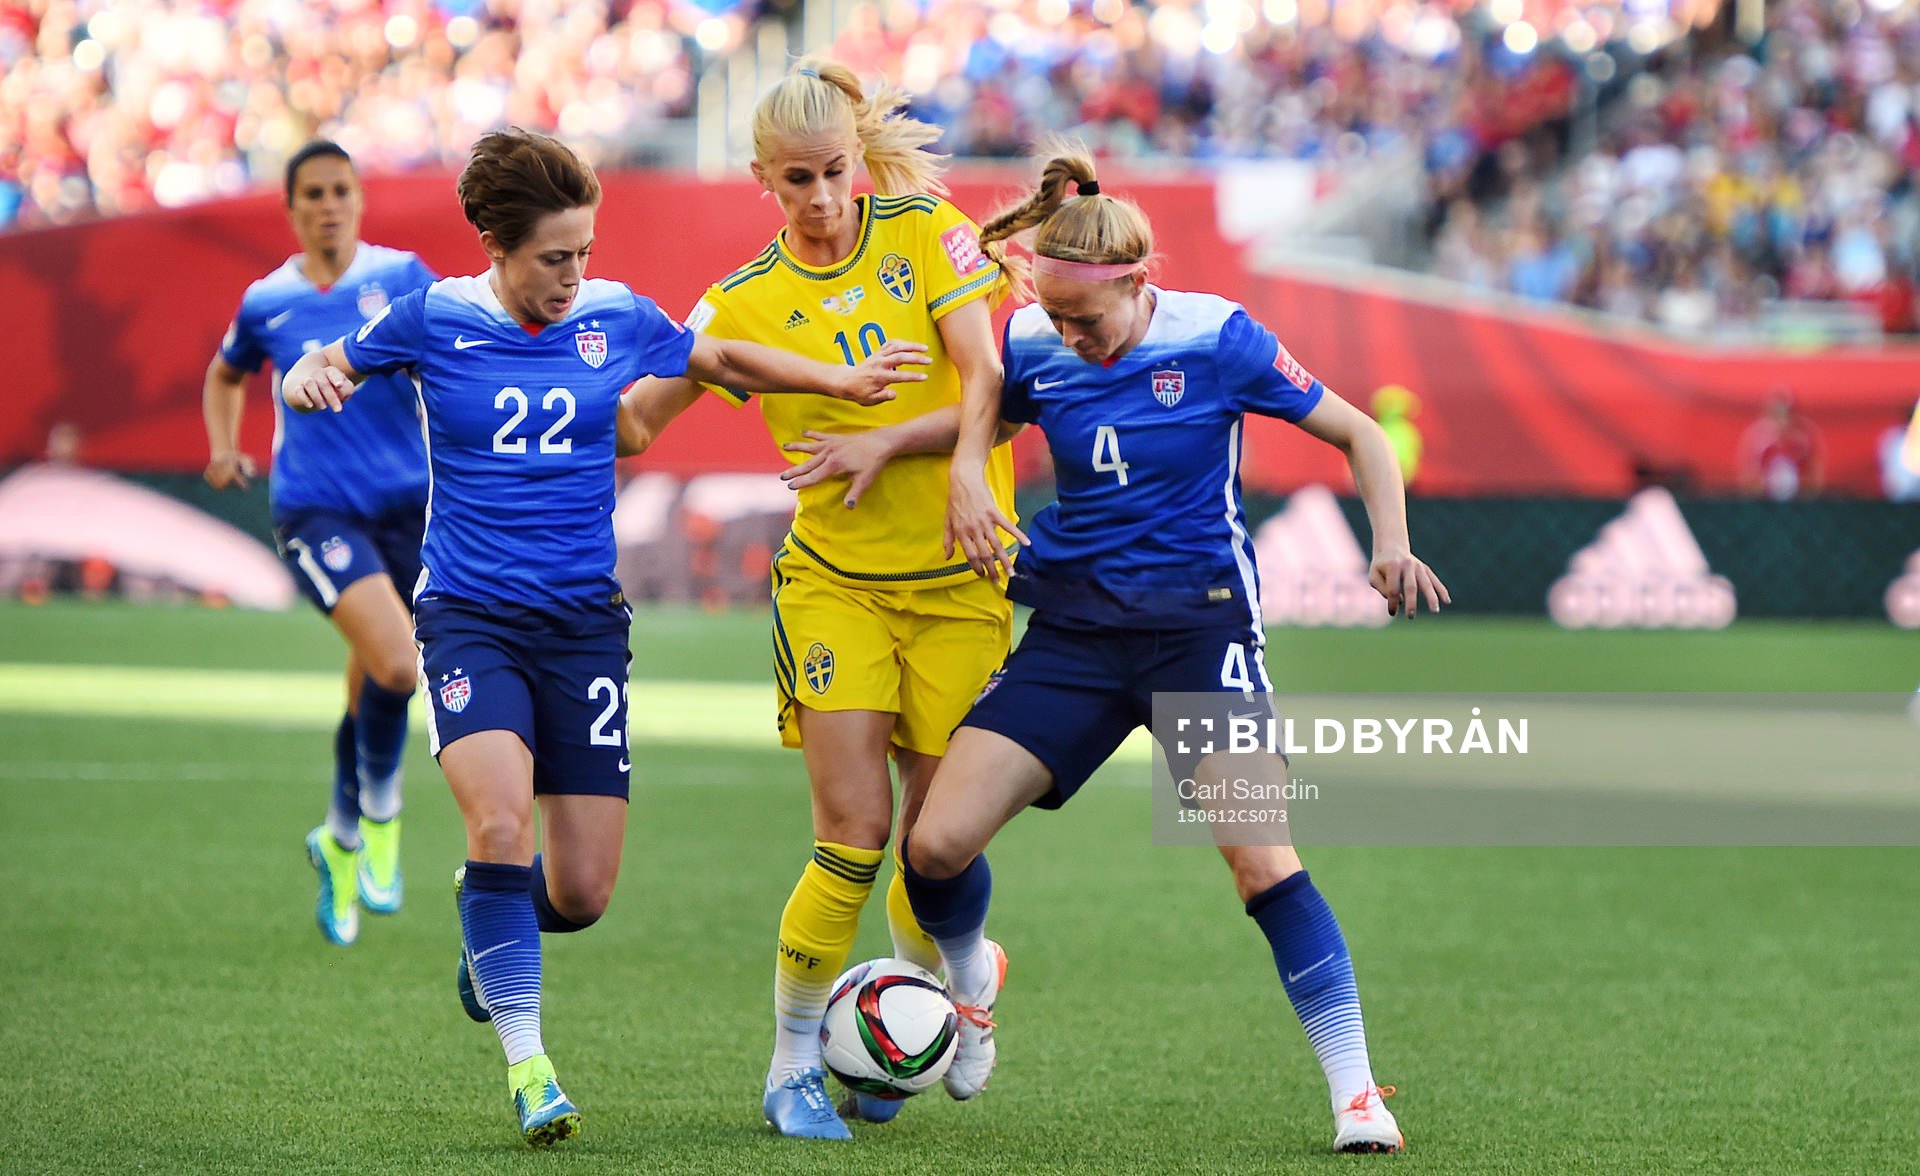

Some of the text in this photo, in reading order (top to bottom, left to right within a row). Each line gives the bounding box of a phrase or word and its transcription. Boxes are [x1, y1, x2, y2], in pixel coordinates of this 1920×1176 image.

[834, 322, 887, 367] 10
[492, 386, 576, 454] 22
[1092, 425, 1129, 486] 4
[1221, 642, 1255, 703] 4
[588, 677, 630, 751] 2
